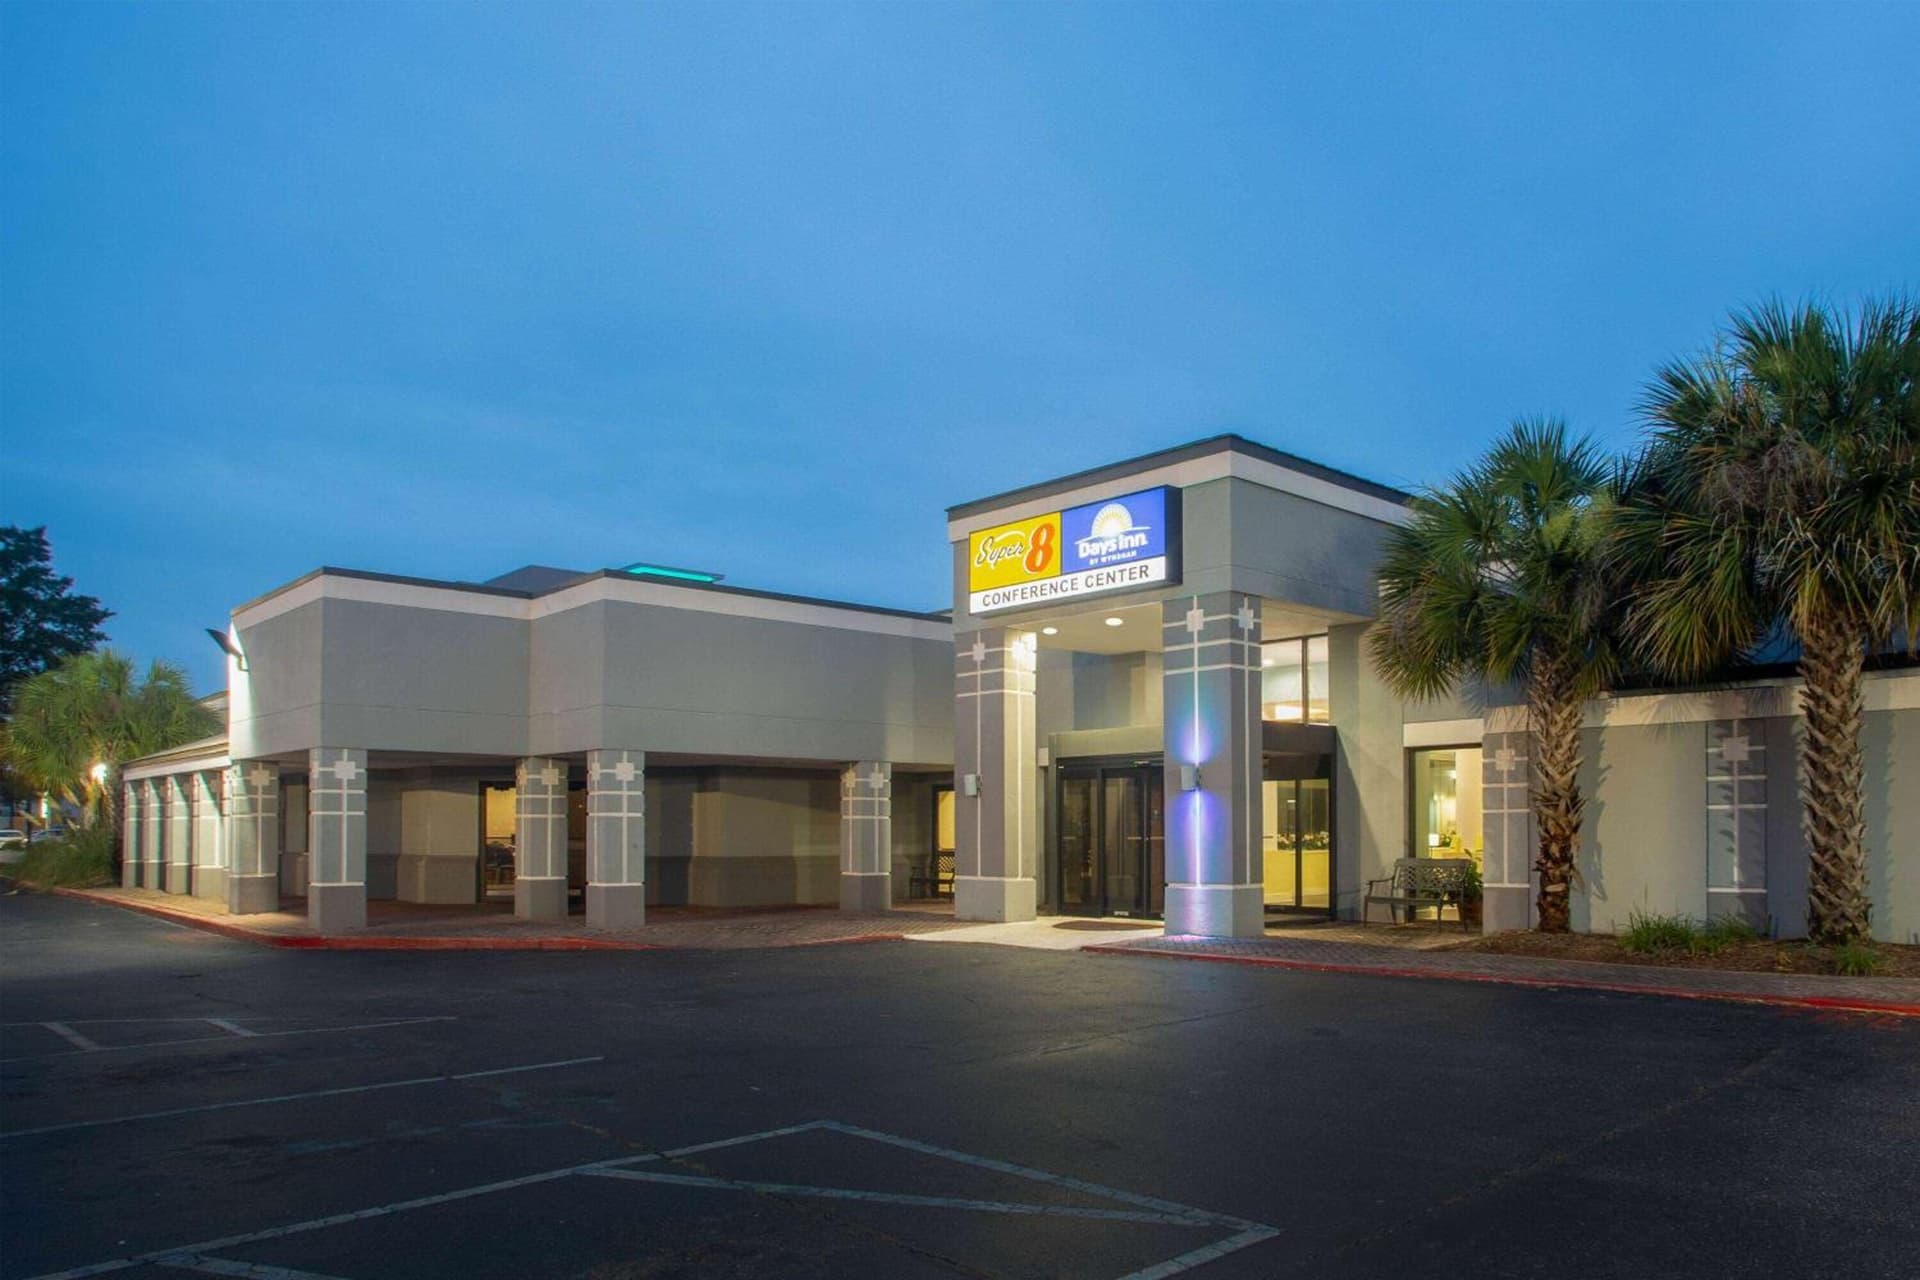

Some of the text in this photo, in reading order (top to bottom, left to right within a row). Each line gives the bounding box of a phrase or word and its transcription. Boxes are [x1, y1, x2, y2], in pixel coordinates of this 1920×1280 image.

[975, 523, 1055, 574] Super 8
[1079, 539, 1118, 558] Days
[982, 565, 1149, 607] CONFERENCE CENTER
